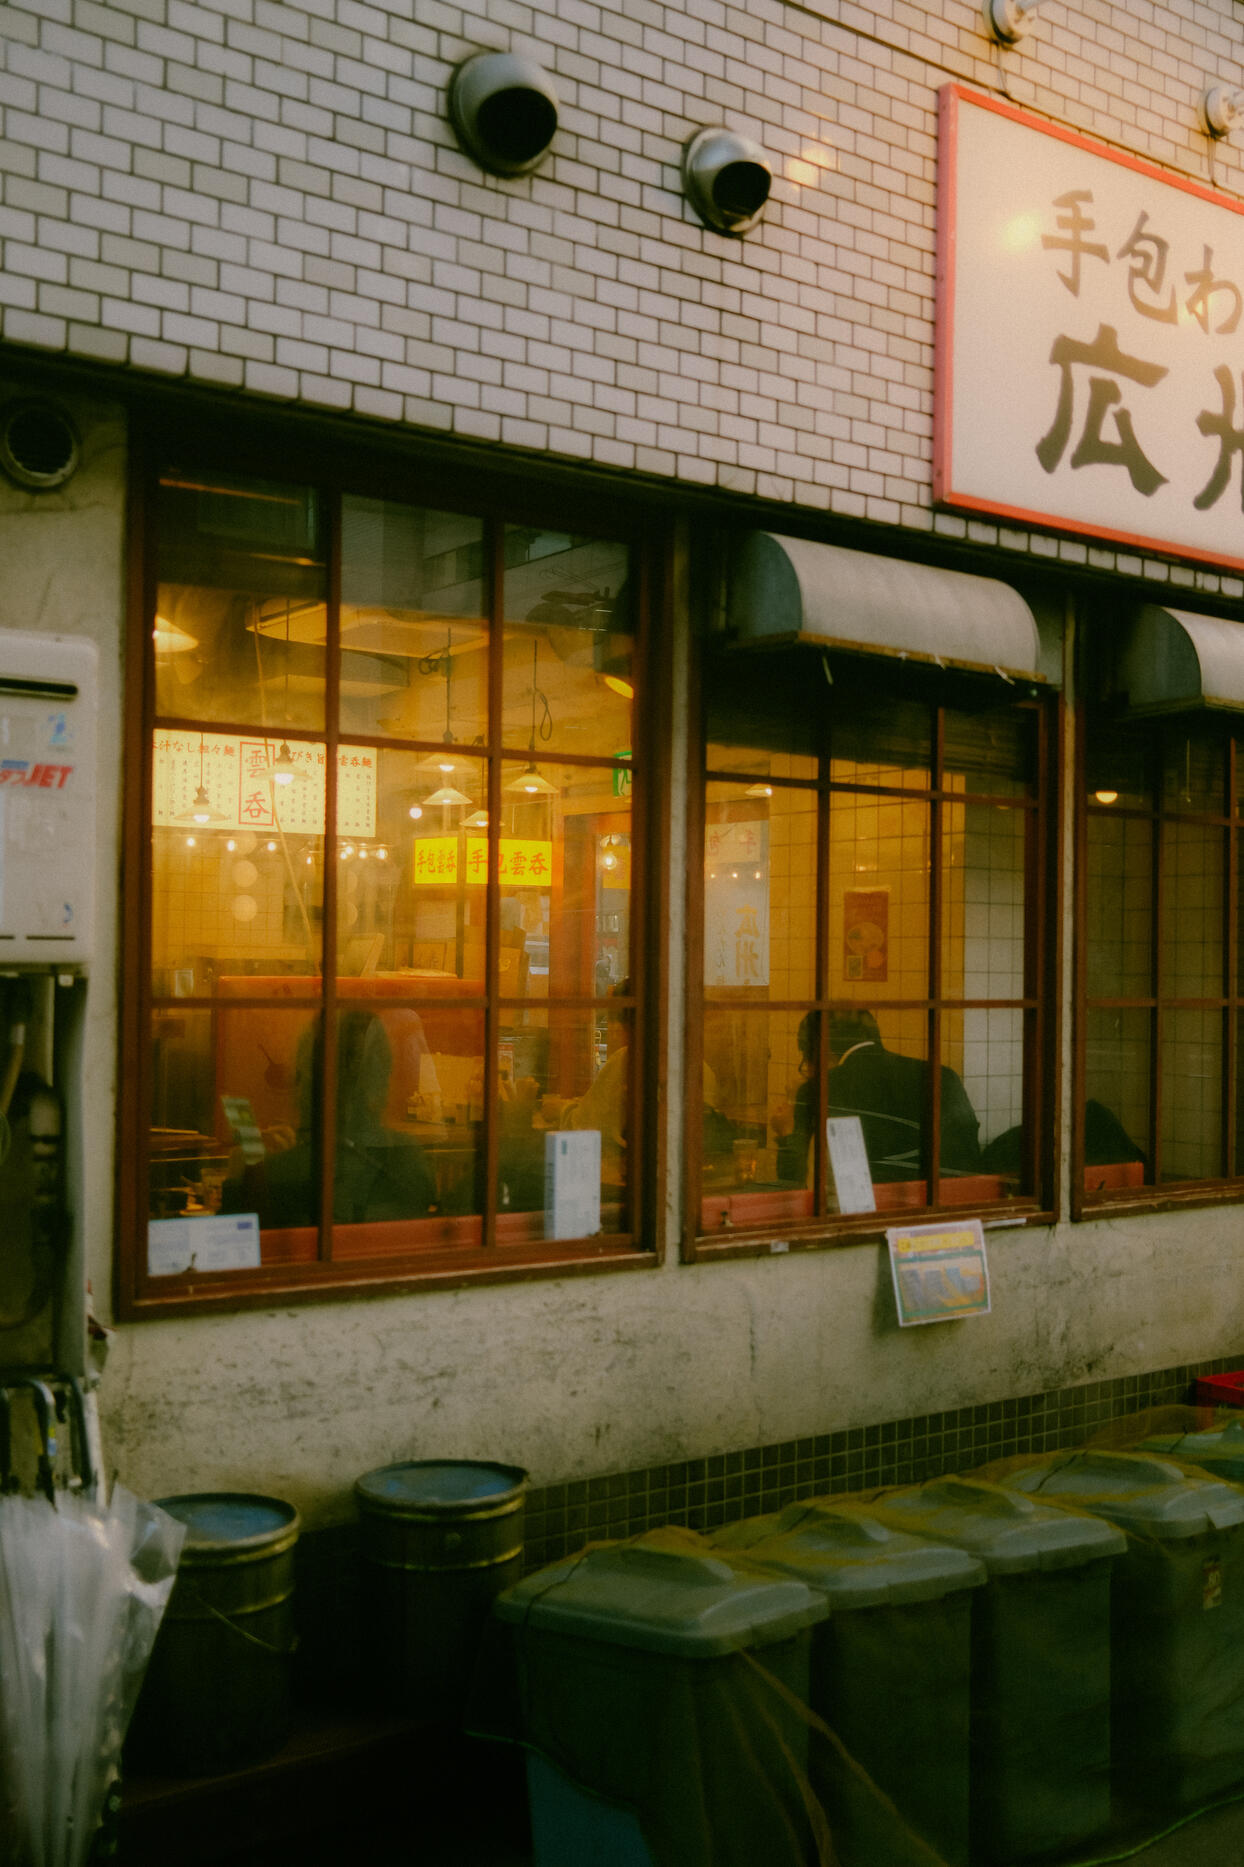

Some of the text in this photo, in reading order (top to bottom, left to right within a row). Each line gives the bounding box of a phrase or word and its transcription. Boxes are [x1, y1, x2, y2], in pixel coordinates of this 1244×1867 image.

[1041, 188, 1244, 335] 手包わ
[244, 750, 270, 818] 雲呑
